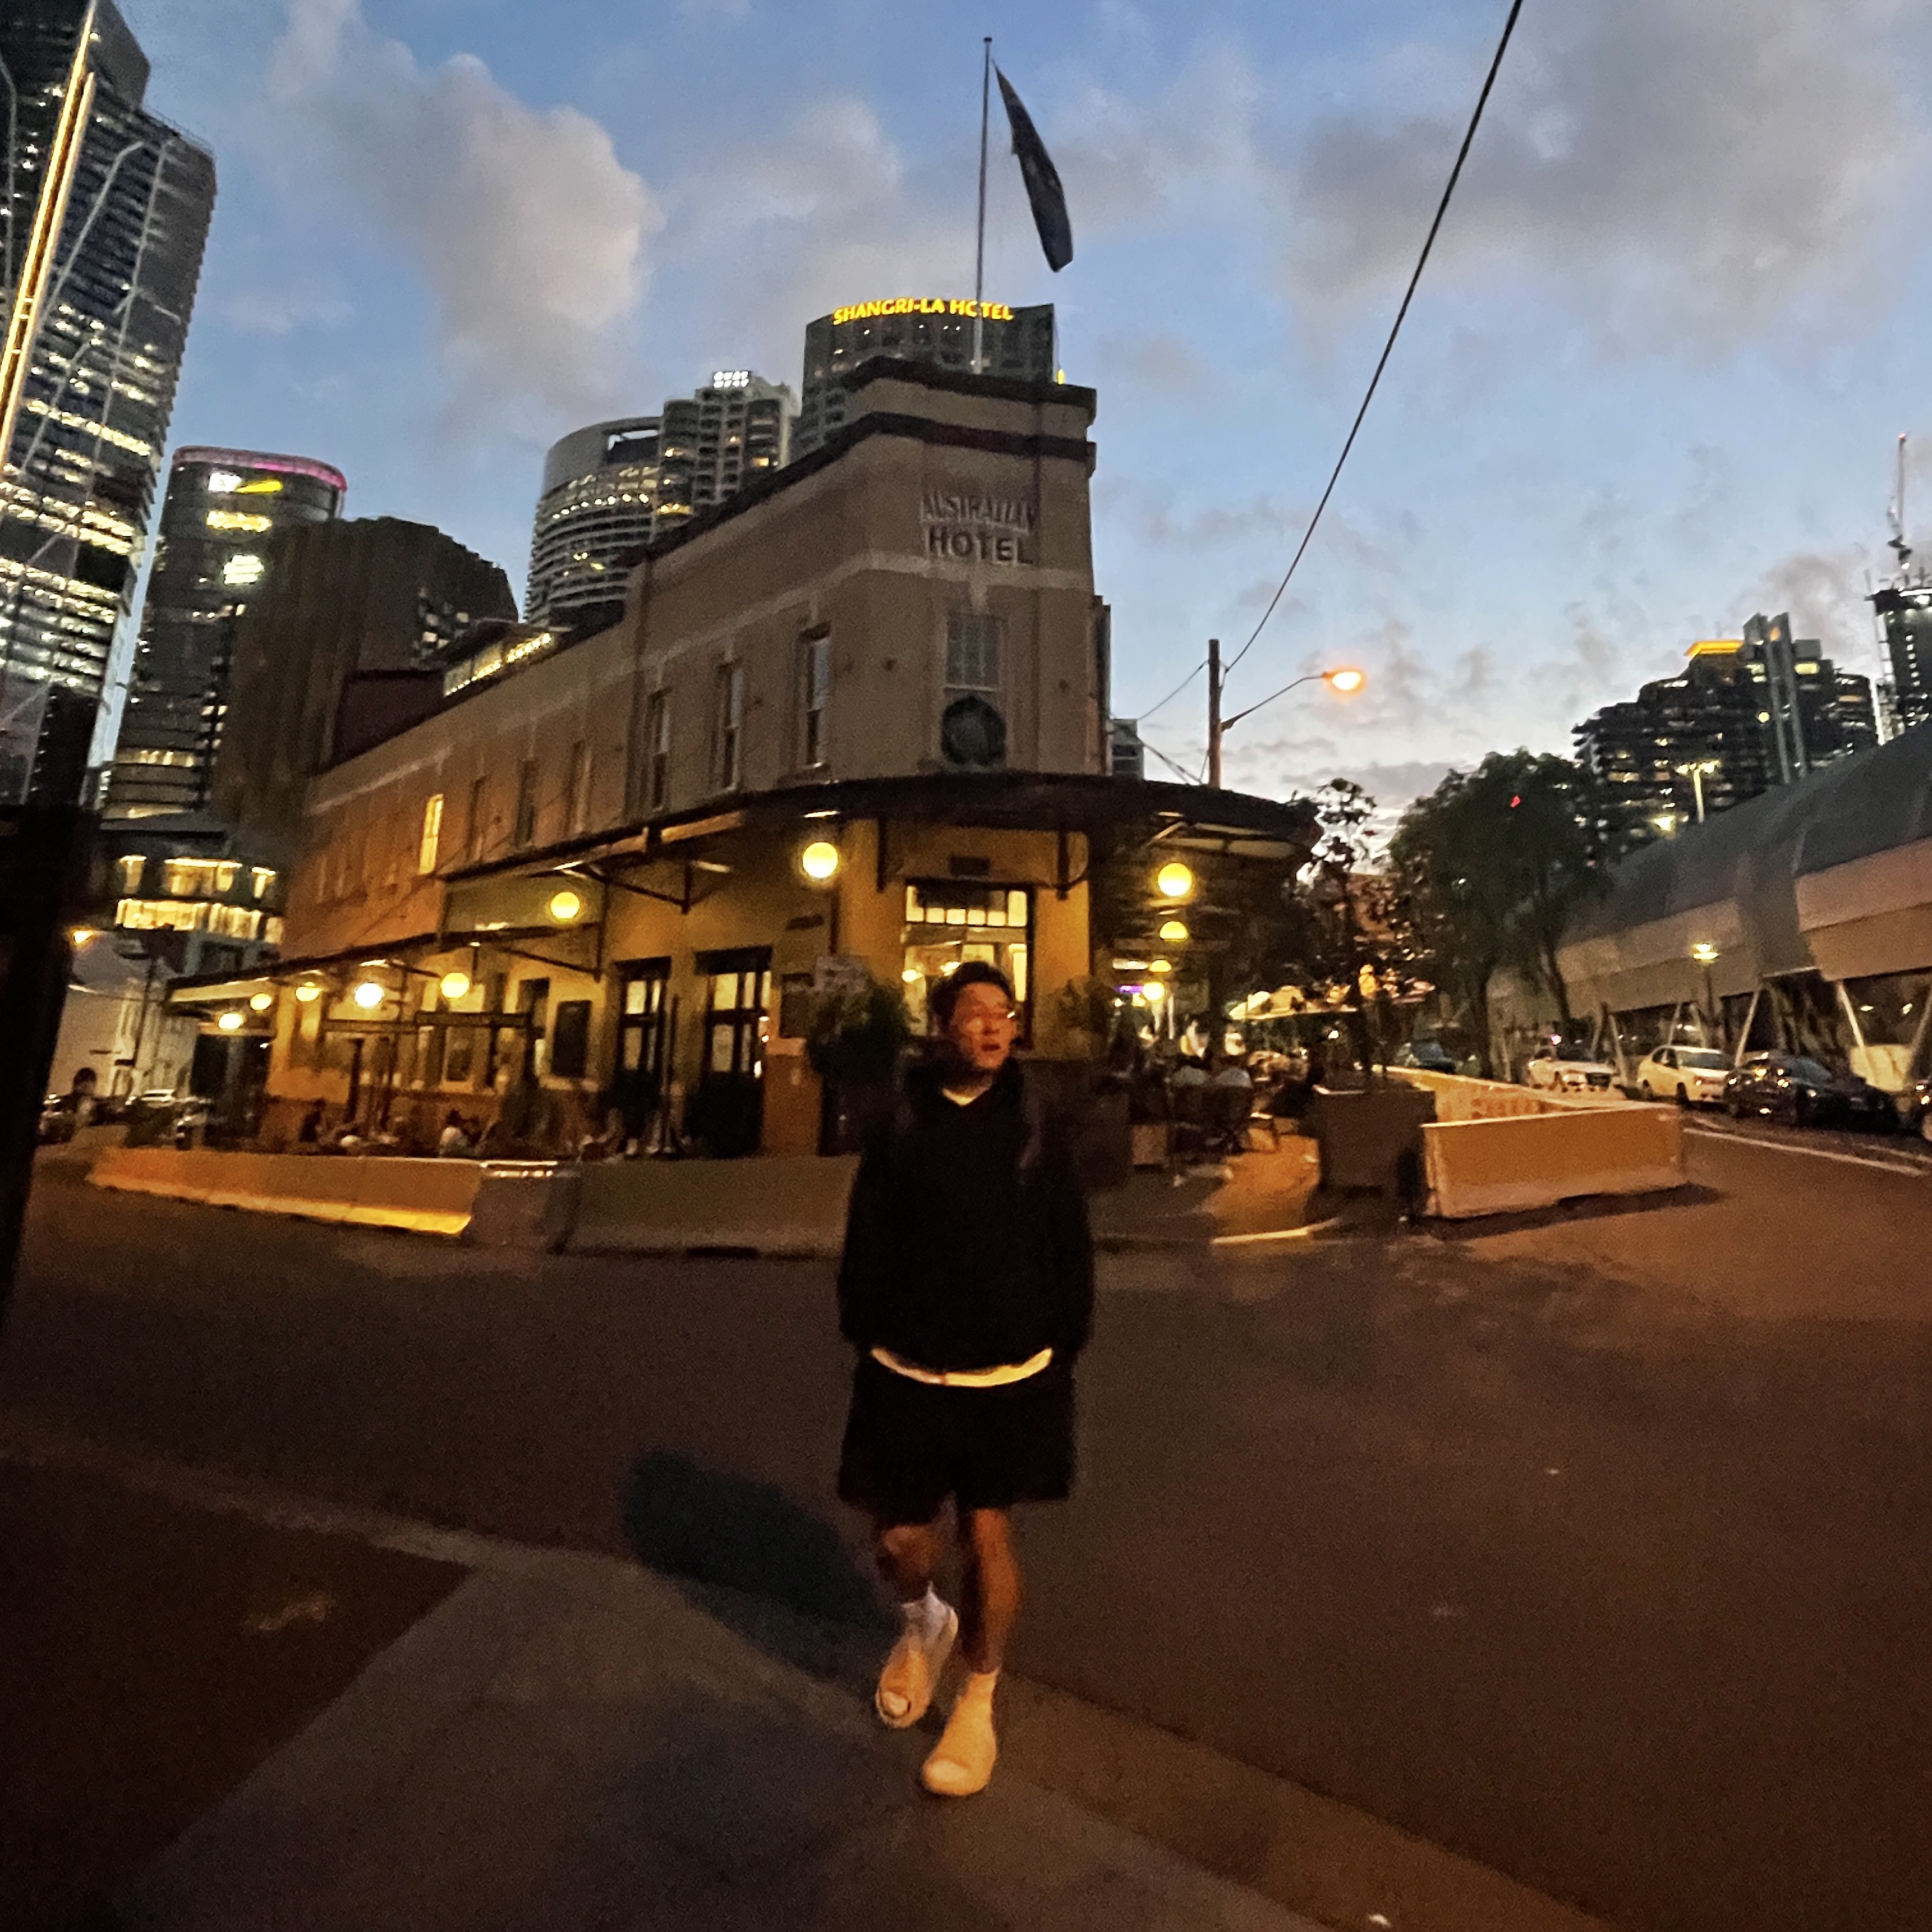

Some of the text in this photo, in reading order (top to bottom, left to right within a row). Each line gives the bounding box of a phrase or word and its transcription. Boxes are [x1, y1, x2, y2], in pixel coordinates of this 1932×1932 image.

[832, 298, 1015, 325] SHANGRI-LA HOTEL
[923, 526, 1034, 564] HOTEL
